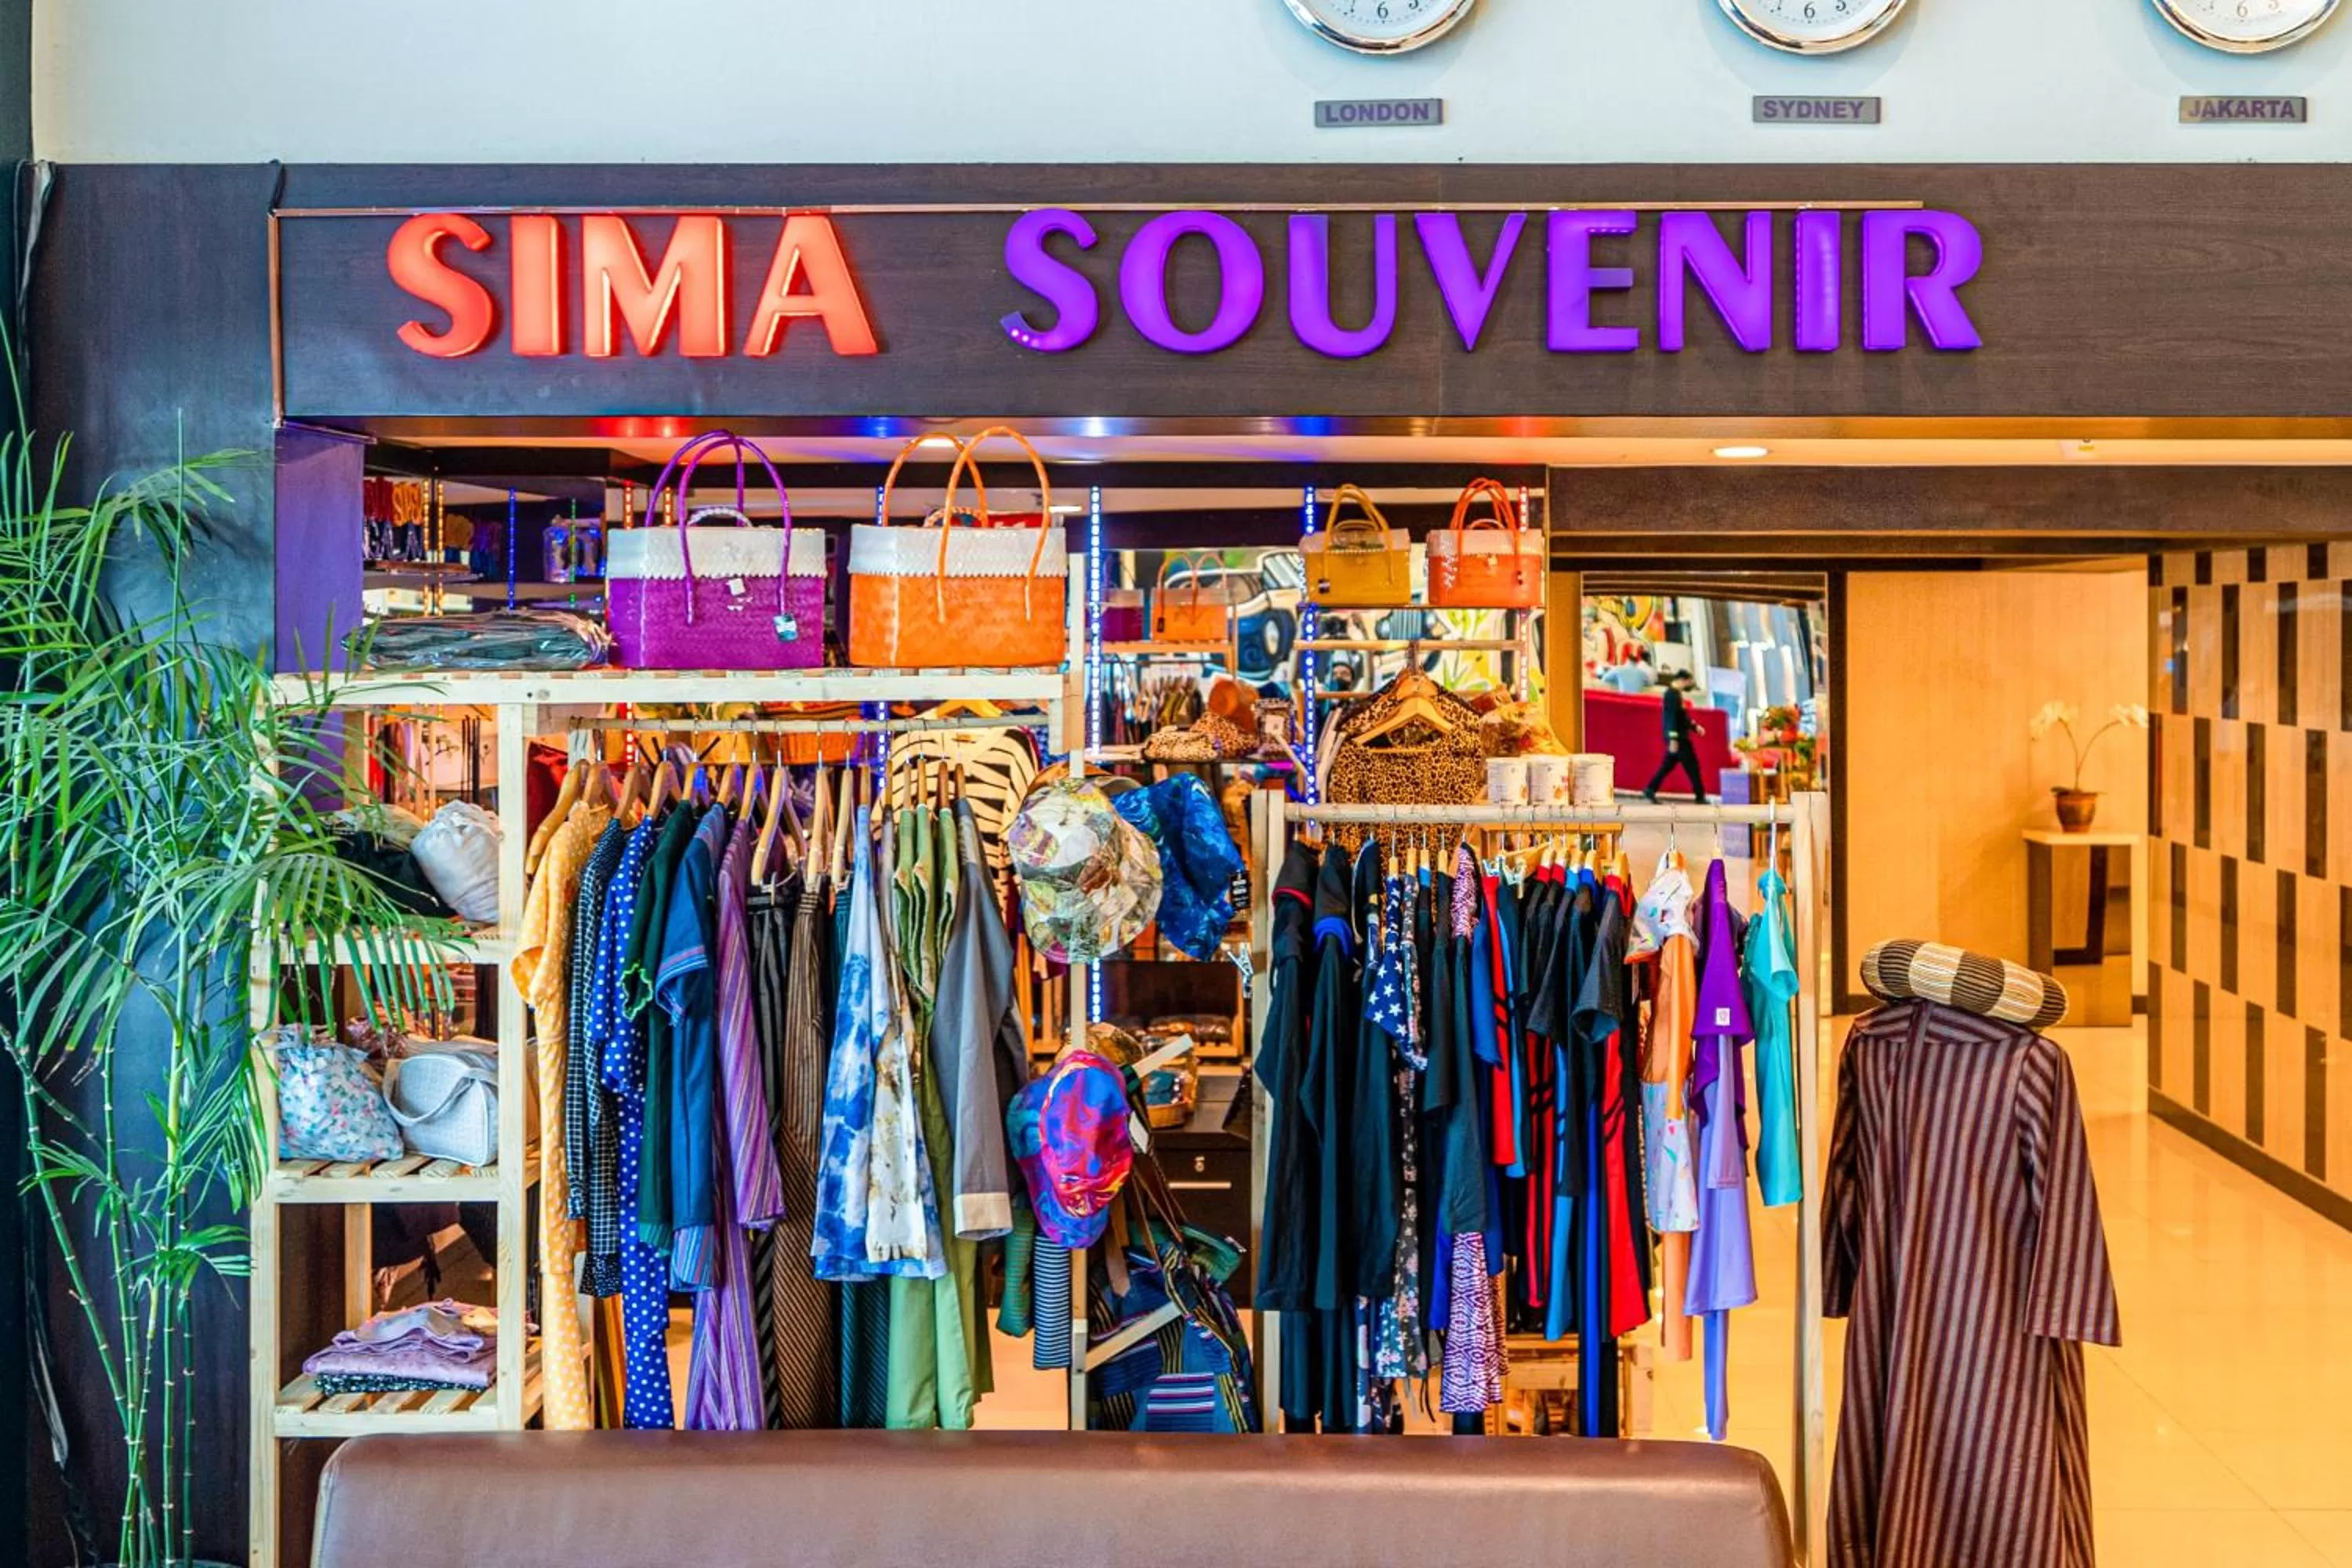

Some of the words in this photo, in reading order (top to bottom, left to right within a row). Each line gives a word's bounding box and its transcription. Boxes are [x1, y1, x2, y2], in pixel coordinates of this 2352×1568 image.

[1377, 2, 1388, 19] 6
[1804, 2, 1815, 19] 6
[2237, 0, 2248, 17] 6
[1325, 103, 1429, 122] LONDON
[1763, 100, 1864, 118] SYDNEY
[2188, 100, 2296, 118] JAKARTA
[387, 212, 879, 358] SIMA
[1001, 207, 1984, 358] SOUVENIR
